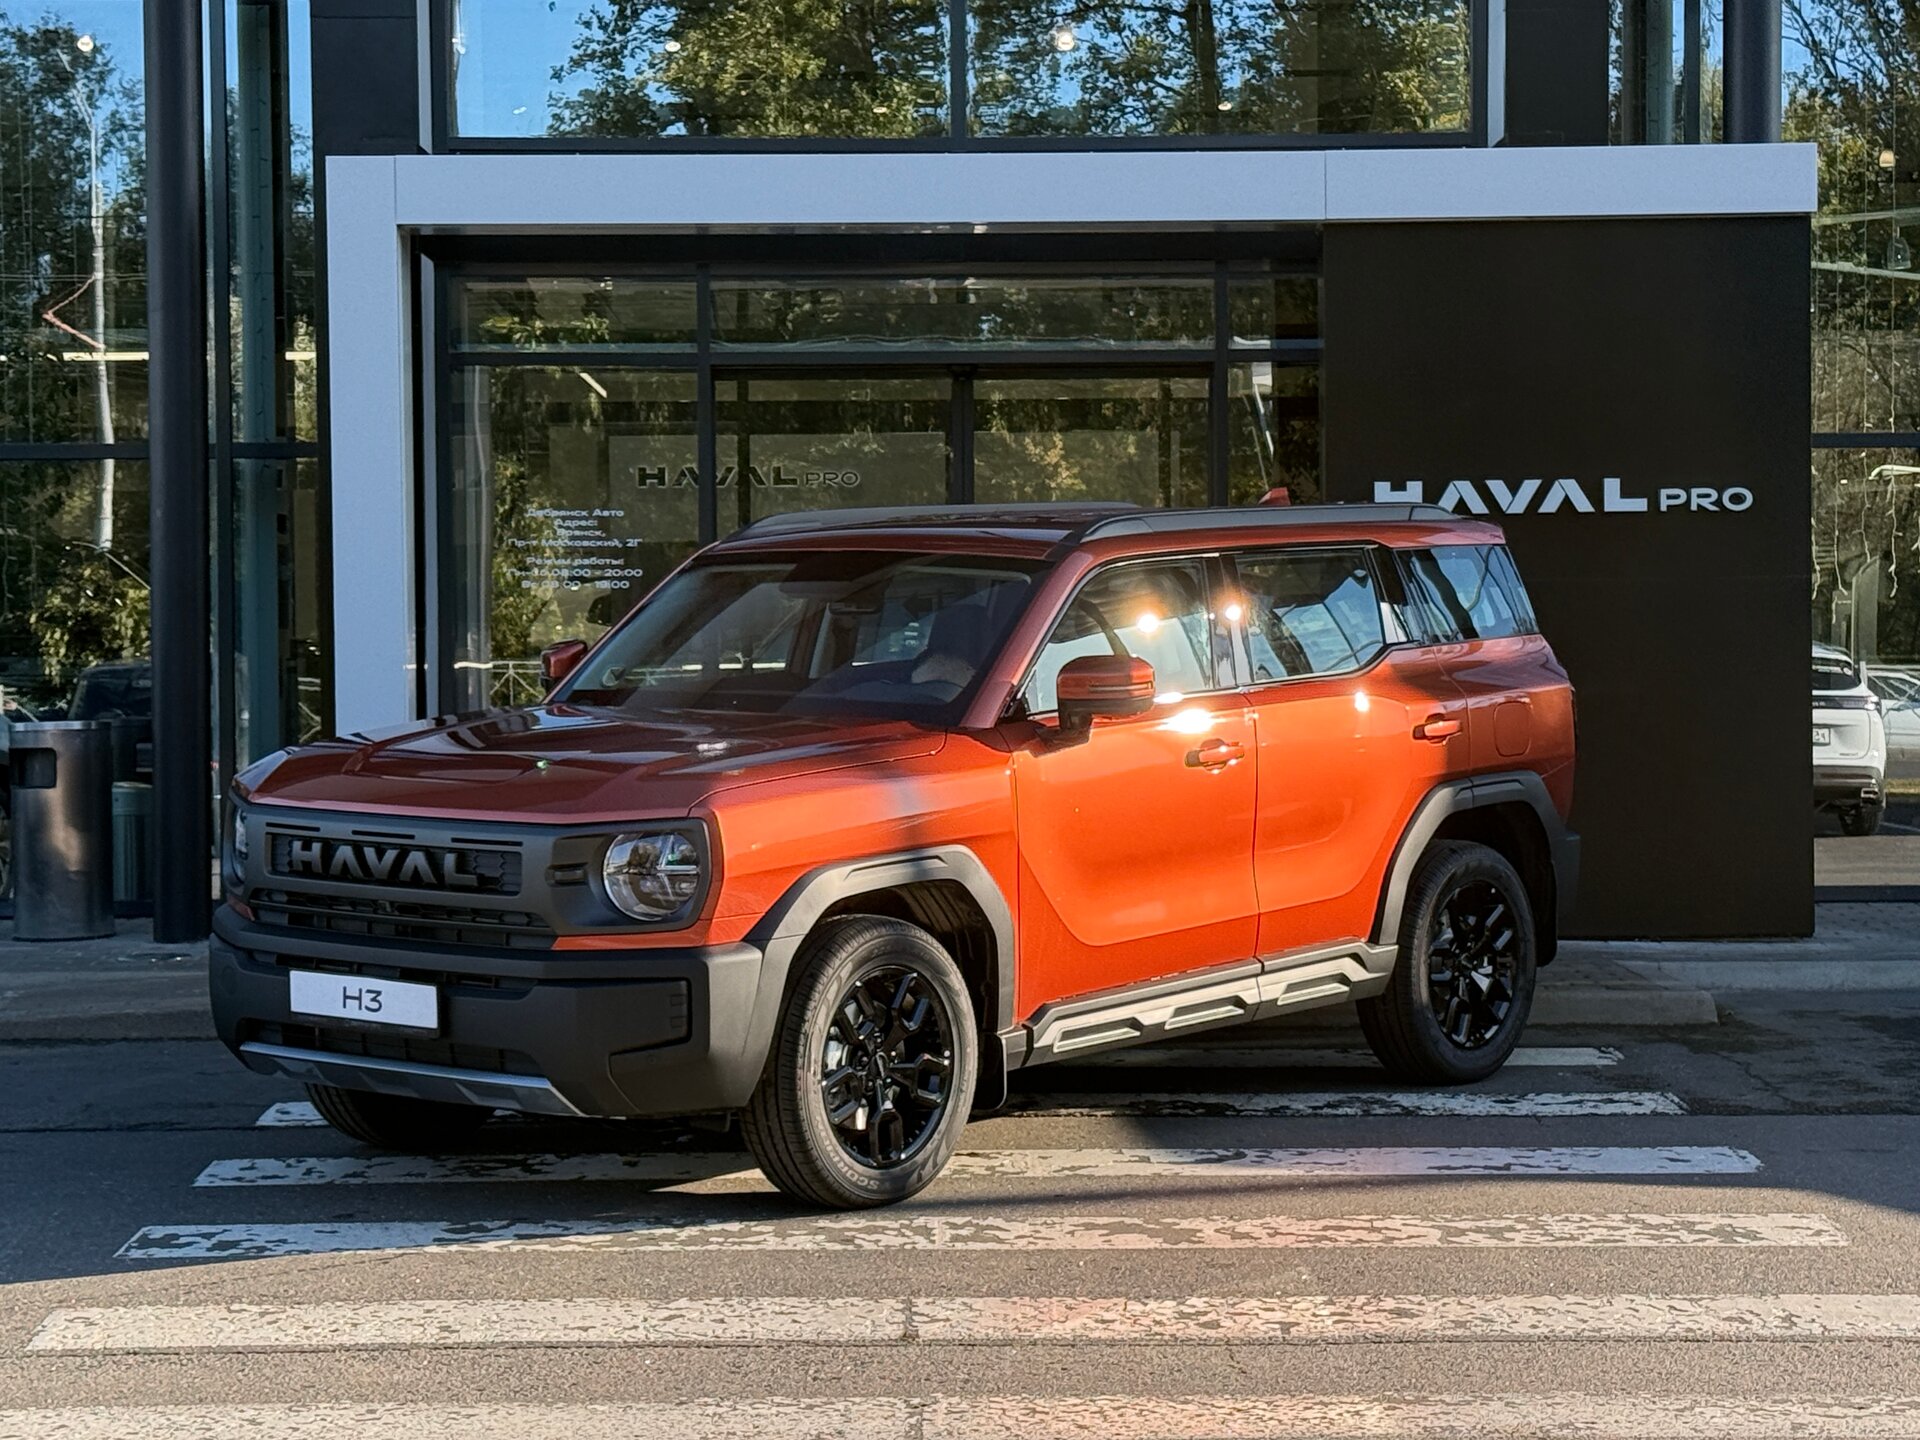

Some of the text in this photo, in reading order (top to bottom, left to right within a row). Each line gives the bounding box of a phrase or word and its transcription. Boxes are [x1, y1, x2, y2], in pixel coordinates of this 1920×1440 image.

[805, 471, 860, 488] PRO
[1374, 478, 1754, 514] HAVAL PRO
[592, 508, 624, 517] Авто
[554, 519, 598, 529] Адрес:
[604, 568, 643, 577] 20:00
[292, 840, 479, 887] HAVAL
[342, 985, 383, 1013] H3
